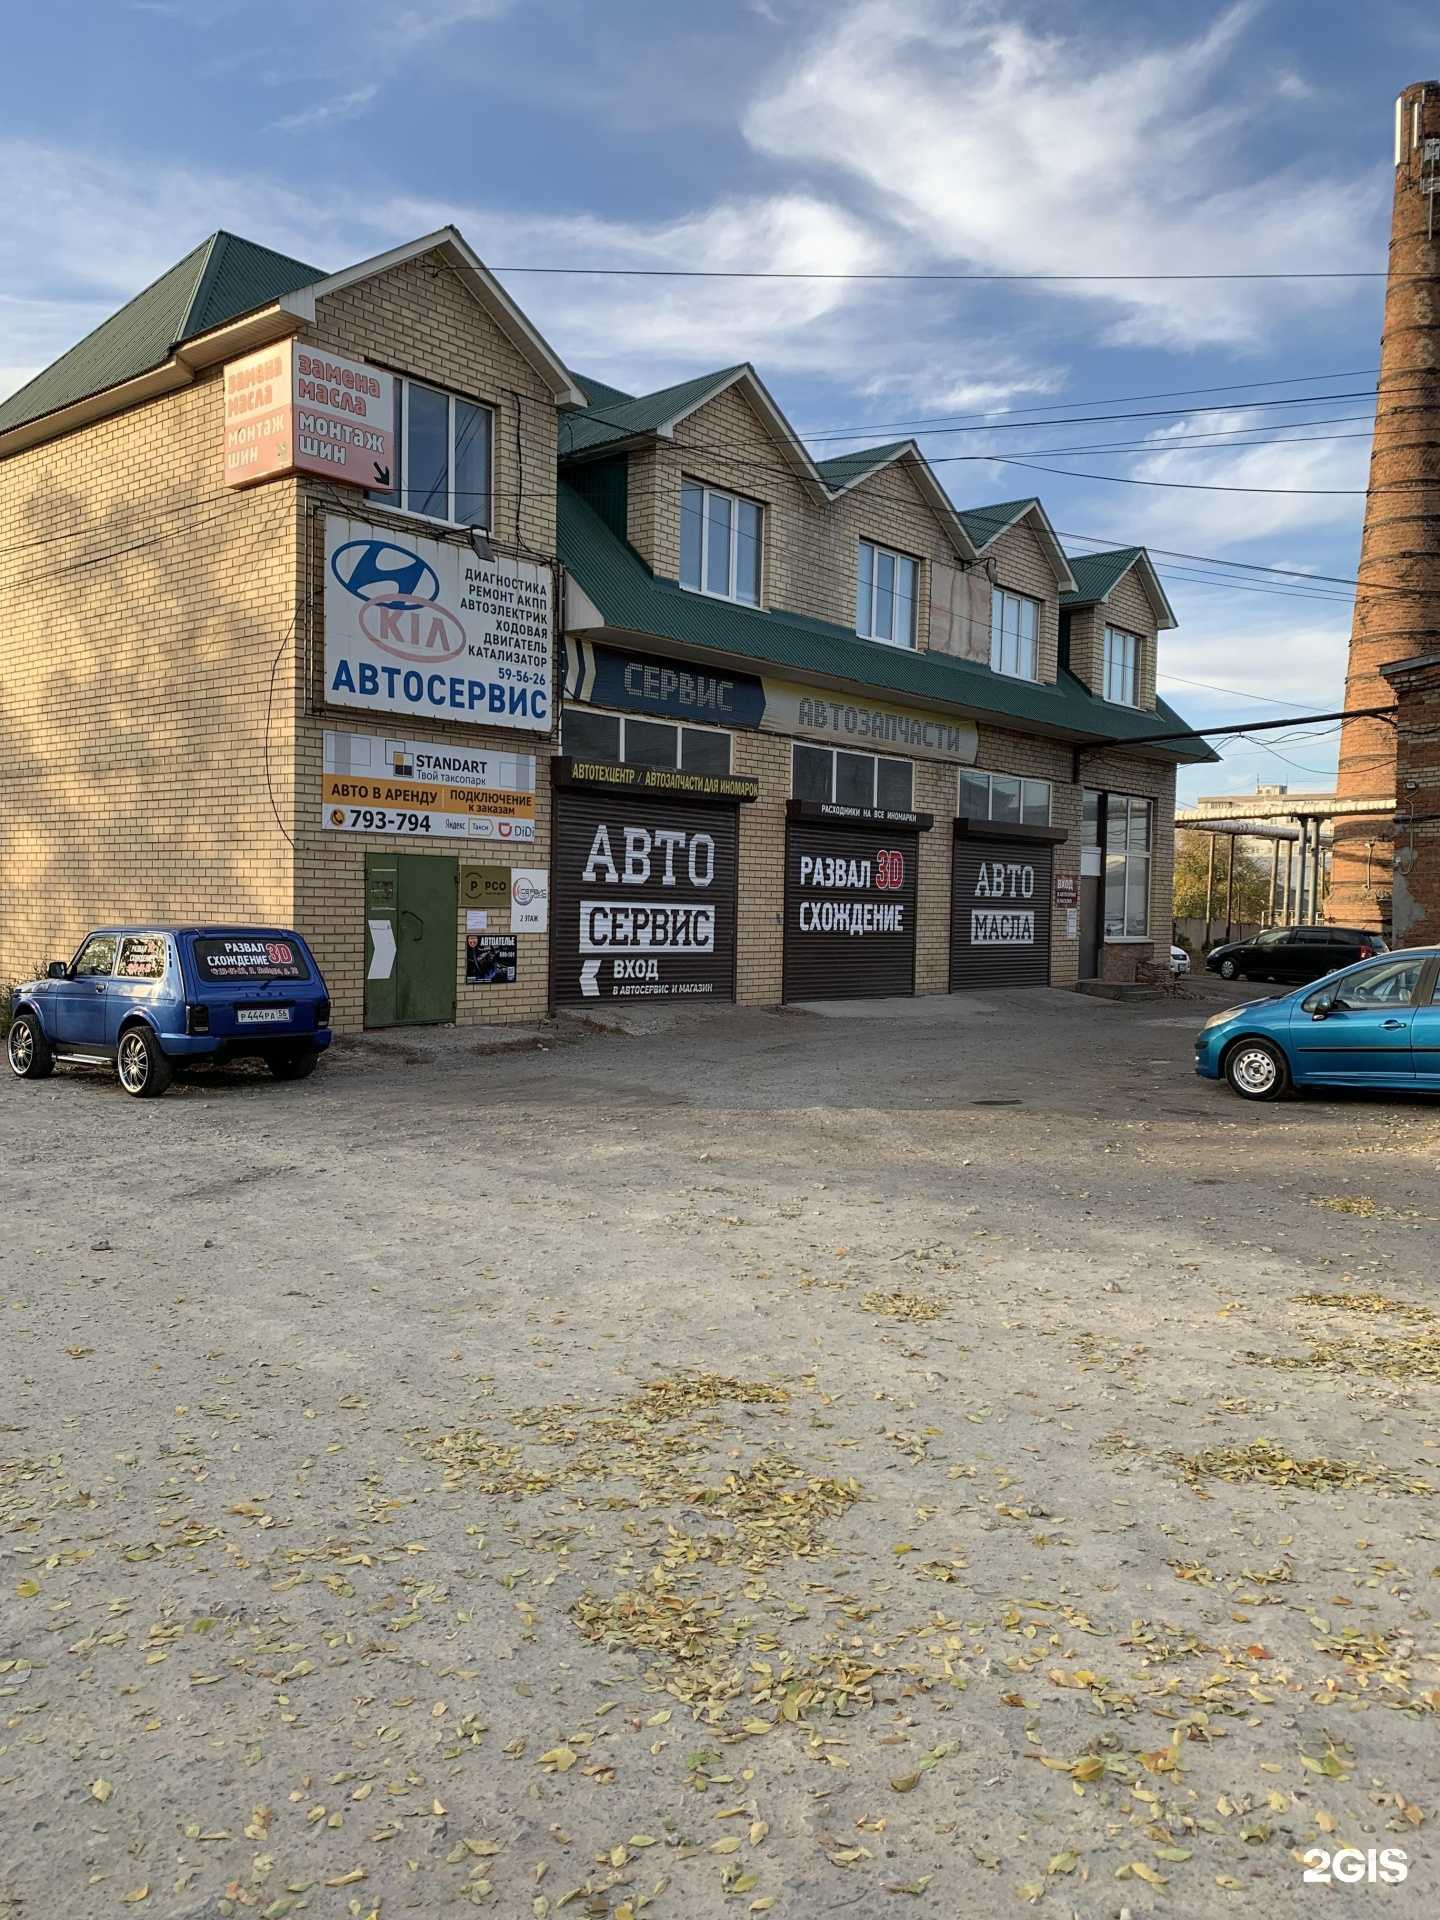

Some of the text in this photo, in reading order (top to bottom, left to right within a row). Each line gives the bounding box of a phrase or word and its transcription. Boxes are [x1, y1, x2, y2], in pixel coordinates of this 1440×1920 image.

[227, 384, 273, 418] масла
[298, 378, 367, 417] масла
[299, 411, 385, 453] монтаж
[227, 447, 258, 469] шин
[300, 435, 347, 465] шин
[465, 568, 547, 596] ДИАГНОСТИКА
[469, 584, 547, 610] РЕМОНТ АКПП
[460, 598, 548, 624] АВТОЭЛЕКТРИК
[379, 607, 451, 652] KIA
[496, 620, 548, 640] ХОДОВАЯ
[484, 632, 548, 654] ДВИГАТЕЛЬ
[468, 645, 547, 668] КАТАЛИЗАТОР
[331, 659, 548, 719] АВТОСЕРВИС
[498, 668, 546, 686] 59-56-26
[624, 662, 735, 712] СЕРВИС
[798, 697, 961, 752] АВТОЗАПЧАСТИ
[416, 754, 487, 774] STANDART
[417, 770, 486, 786] Твой таксопарк
[572, 763, 635, 784] АВТОТЕХЦЕНТР
[645, 771, 703, 792] АВТОЗАПЧАСТИ
[704, 778, 719, 793] ДЛЯ
[720, 780, 759, 797] ИНОМАРОК
[331, 783, 438, 806] АВТО В АРЕНДУ
[450, 789, 533, 807] ПОДКЛЮЧЕНИЕ
[350, 809, 431, 833] 793-794
[468, 803, 515, 815] к заказам
[821, 804, 917, 822] РАСХОДНИКИ НА ВСЕ ИНОМАРКИ
[445, 819, 466, 831] Яндекс
[472, 822, 489, 832] Такси
[514, 825, 535, 838] DiDi
[582, 824, 715, 887] АВТО
[800, 850, 904, 890] РАЗВАЛ 3D
[974, 861, 1035, 898] АВТО
[588, 906, 711, 947] СЕРВИС
[799, 901, 904, 936] СХОЖДЕНИЕ
[973, 913, 1034, 942] МАСЛА
[206, 955, 270, 967] СХОЖДЕНИЕ
[224, 942, 293, 964] РАЗВАЛ 3D
[613, 959, 659, 981] ВХОД
[612, 983, 713, 995] В АВТОСЕРВИС И МАГАЗИН
